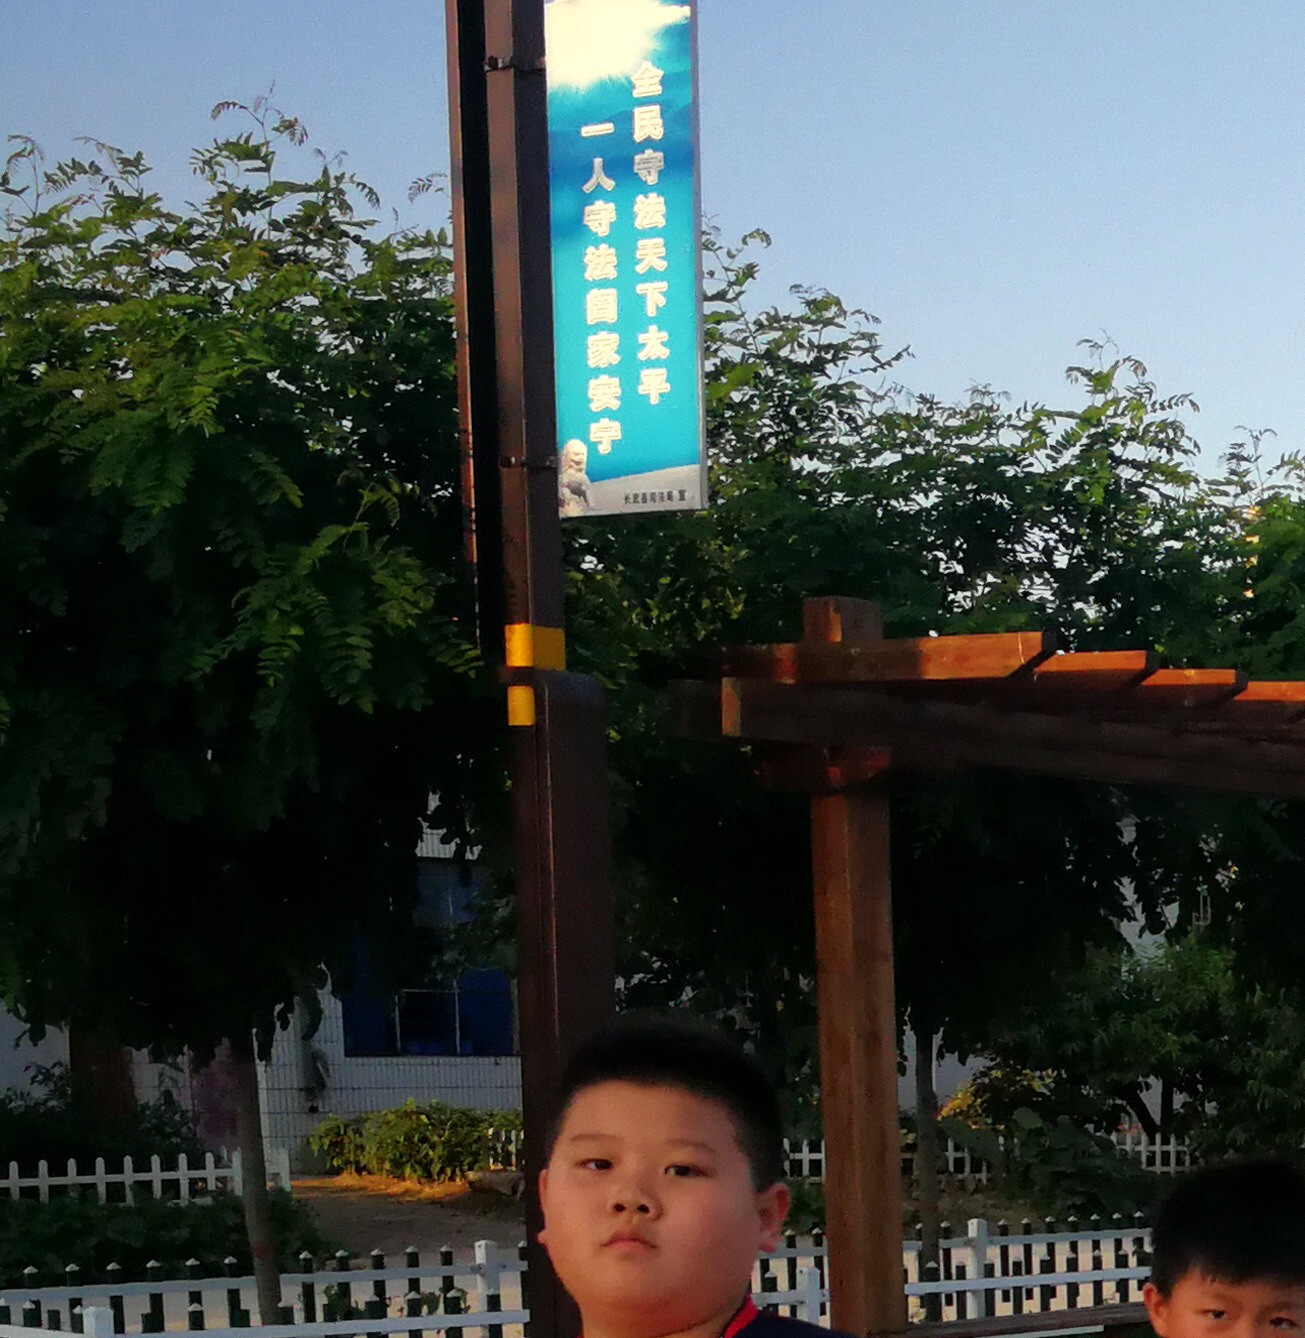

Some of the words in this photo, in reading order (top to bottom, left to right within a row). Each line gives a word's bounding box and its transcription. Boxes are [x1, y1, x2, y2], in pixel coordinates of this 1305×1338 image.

[631, 61, 671, 405] 全民守法天下太平
